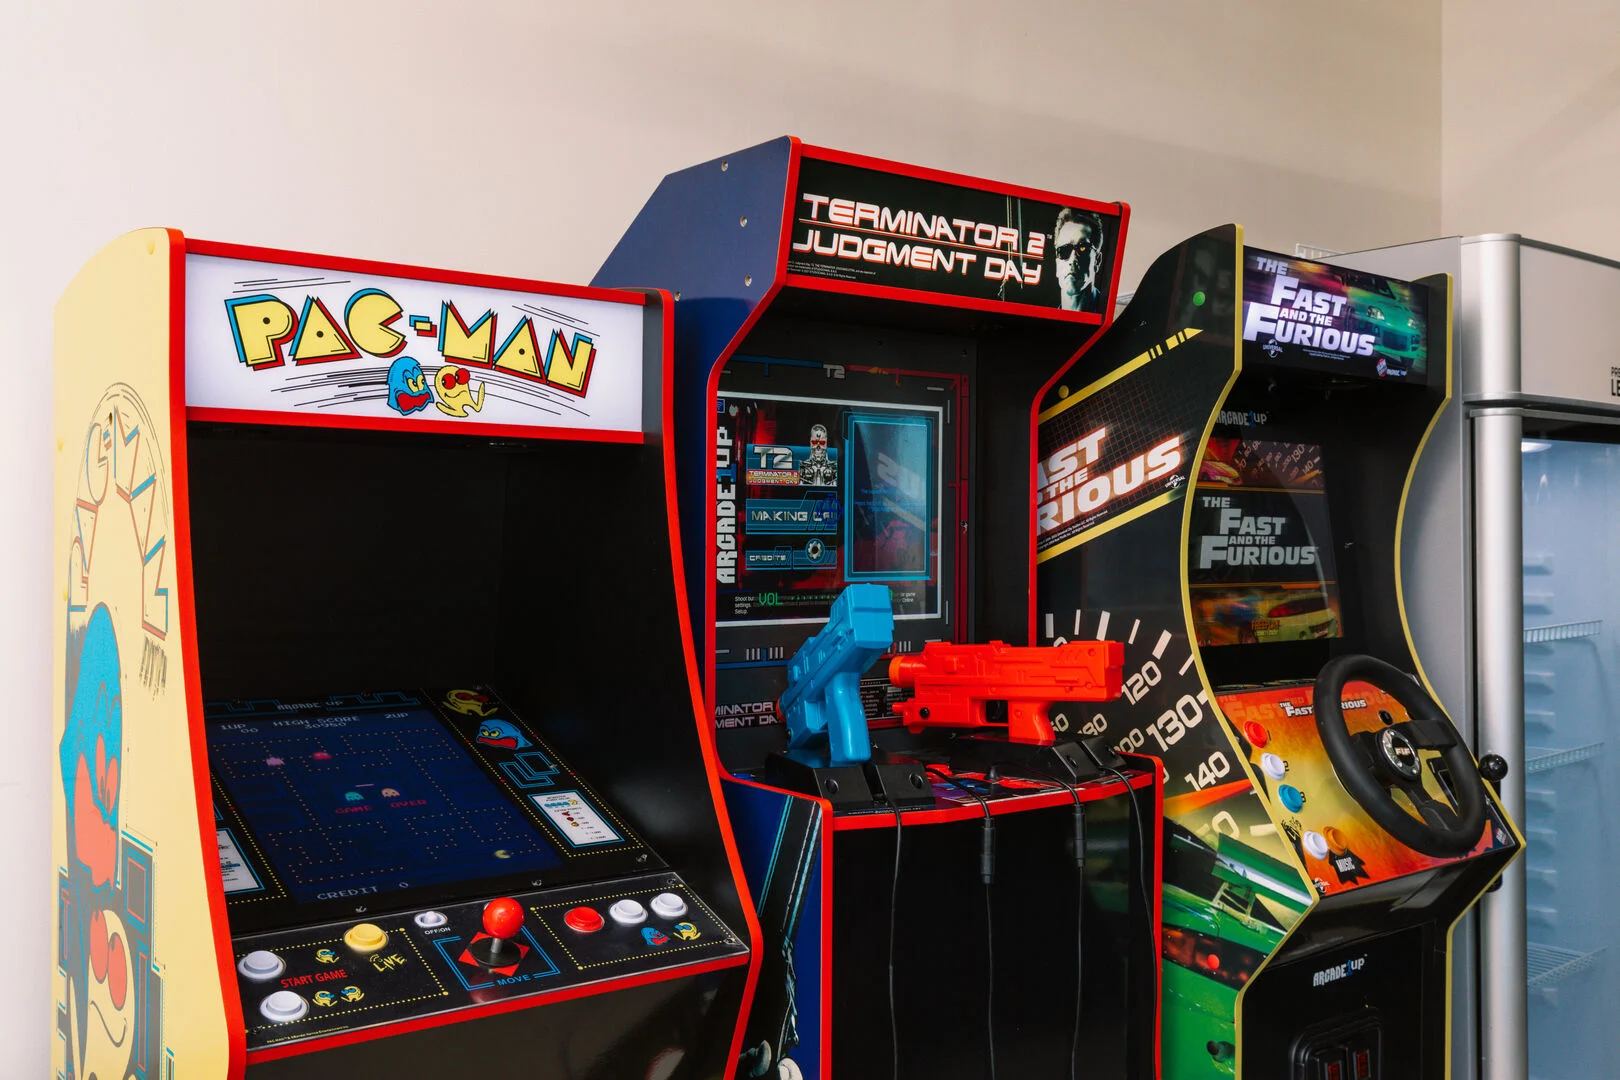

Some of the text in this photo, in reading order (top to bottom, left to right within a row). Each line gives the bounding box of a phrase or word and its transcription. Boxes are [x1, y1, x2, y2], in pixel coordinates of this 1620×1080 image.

[803, 193, 1019, 254] TERMINATOR
[793, 229, 977, 275] JUDGMENT
[984, 255, 1042, 285] DAY
[1256, 256, 1288, 275] THE
[1270, 274, 1347, 316] FAST
[1279, 308, 1333, 326] AND THE
[1243, 301, 1376, 356] FURIOUS
[225, 288, 596, 398] PAC-MAN
[823, 363, 846, 379] T2
[754, 446, 793, 469] T2
[1049, 466, 1089, 498] THE
[1203, 496, 1231, 508] THE
[751, 511, 808, 521] MAKING
[1220, 508, 1286, 535] FAST
[1229, 536, 1276, 545] AND THE
[1200, 536, 1316, 568] FURIOUS
[759, 592, 783, 606] VOL
[1121, 660, 1162, 705] 120
[1279, 701, 1292, 709] THE
[316, 715, 361, 723] SCORE
[759, 714, 779, 725] DA
[1146, 694, 1203, 752] 130
[1184, 751, 1230, 792] 140
[317, 886, 379, 900] CREDIT
[424, 926, 452, 935] OFF/ON
[372, 953, 407, 972] LIVE
[280, 969, 348, 989] START GAME
[496, 973, 532, 986] MOVE
